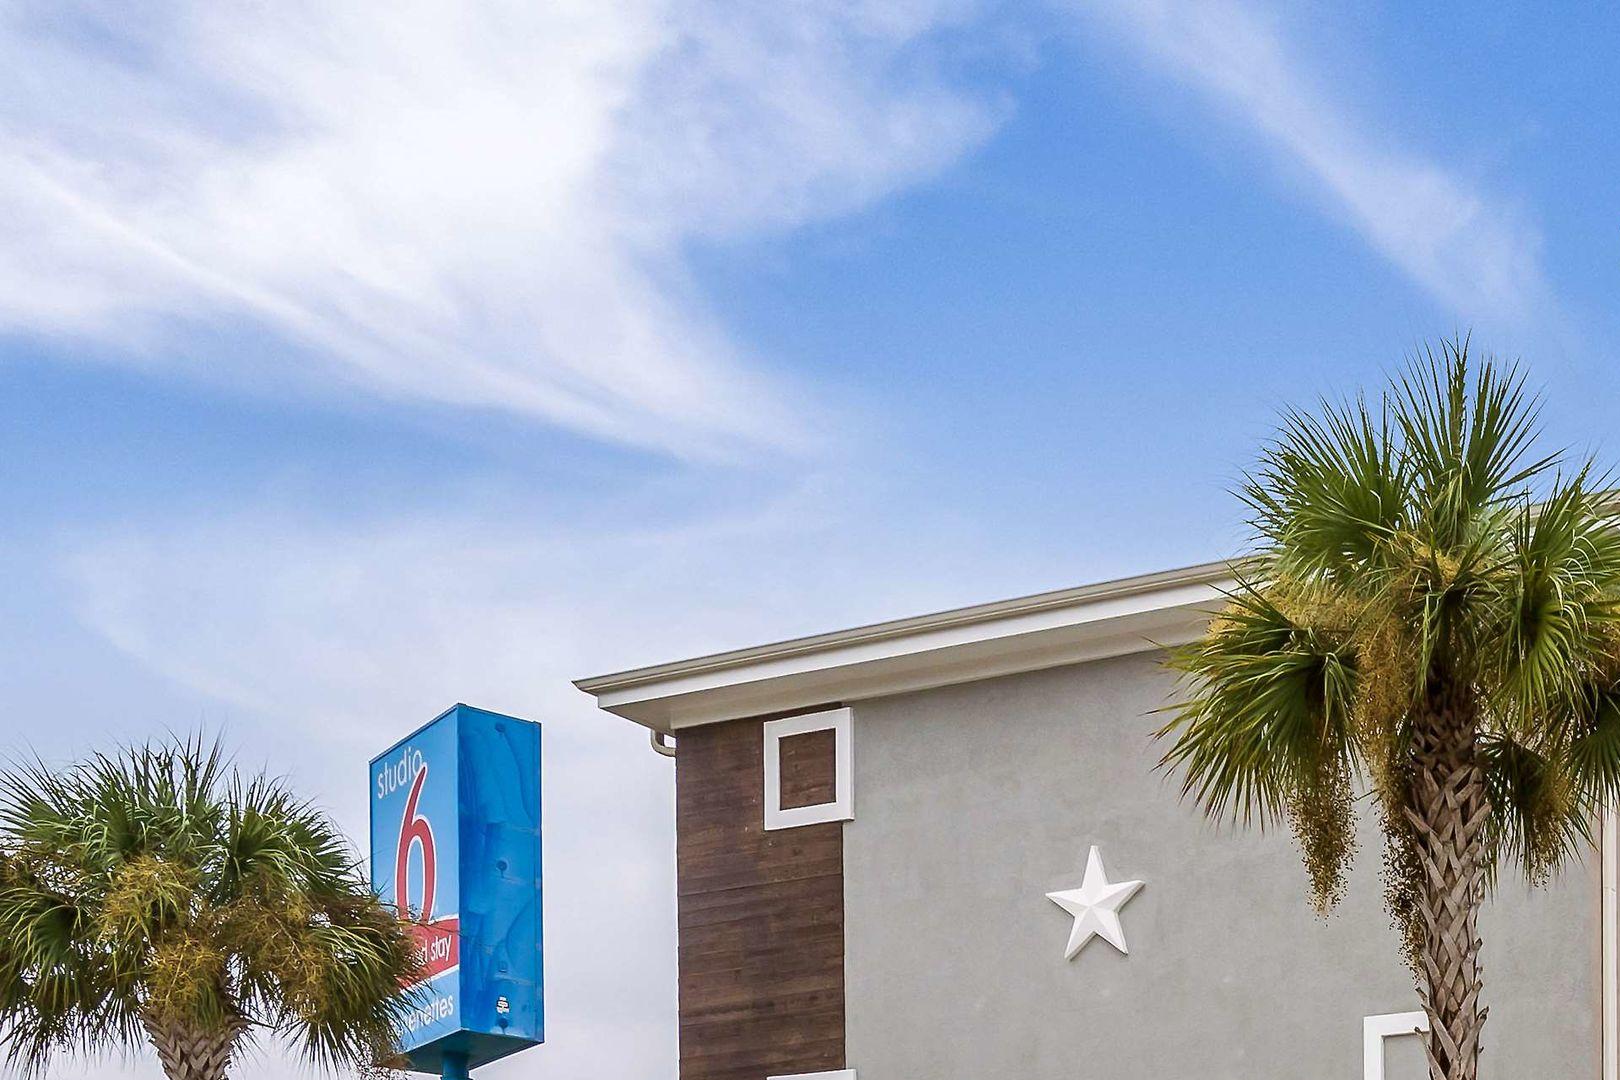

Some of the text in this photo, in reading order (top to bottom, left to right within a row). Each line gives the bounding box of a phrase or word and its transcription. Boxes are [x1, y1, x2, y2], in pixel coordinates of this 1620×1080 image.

[377, 748, 423, 799] studio
[394, 762, 437, 926] 6
[430, 934, 452, 962] stay
